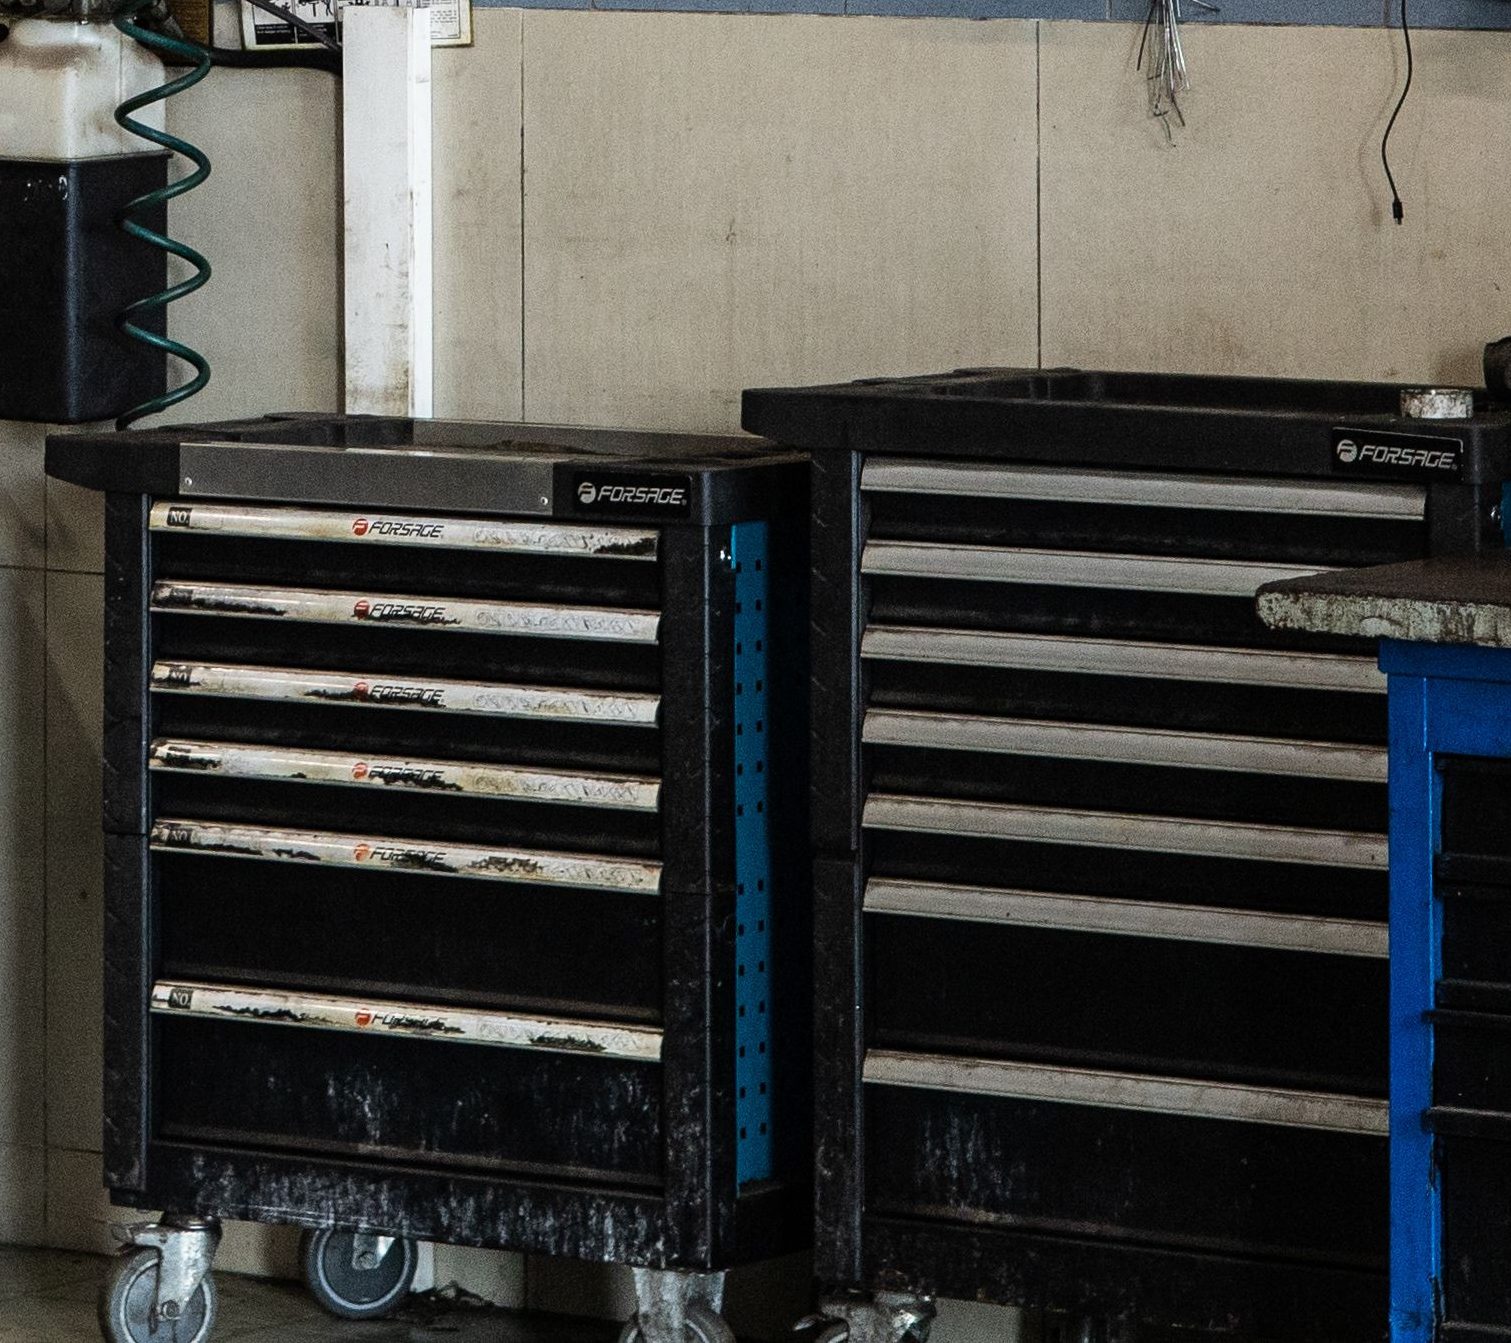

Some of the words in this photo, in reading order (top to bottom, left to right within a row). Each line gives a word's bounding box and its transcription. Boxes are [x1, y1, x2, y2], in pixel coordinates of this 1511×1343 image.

[1359, 445, 1455, 469] FORSAGE
[597, 485, 685, 504] FORSAGE
[369, 521, 445, 538] FORSAGE
[370, 603, 446, 619] FORSAGE
[369, 685, 445, 701] FORSAGE
